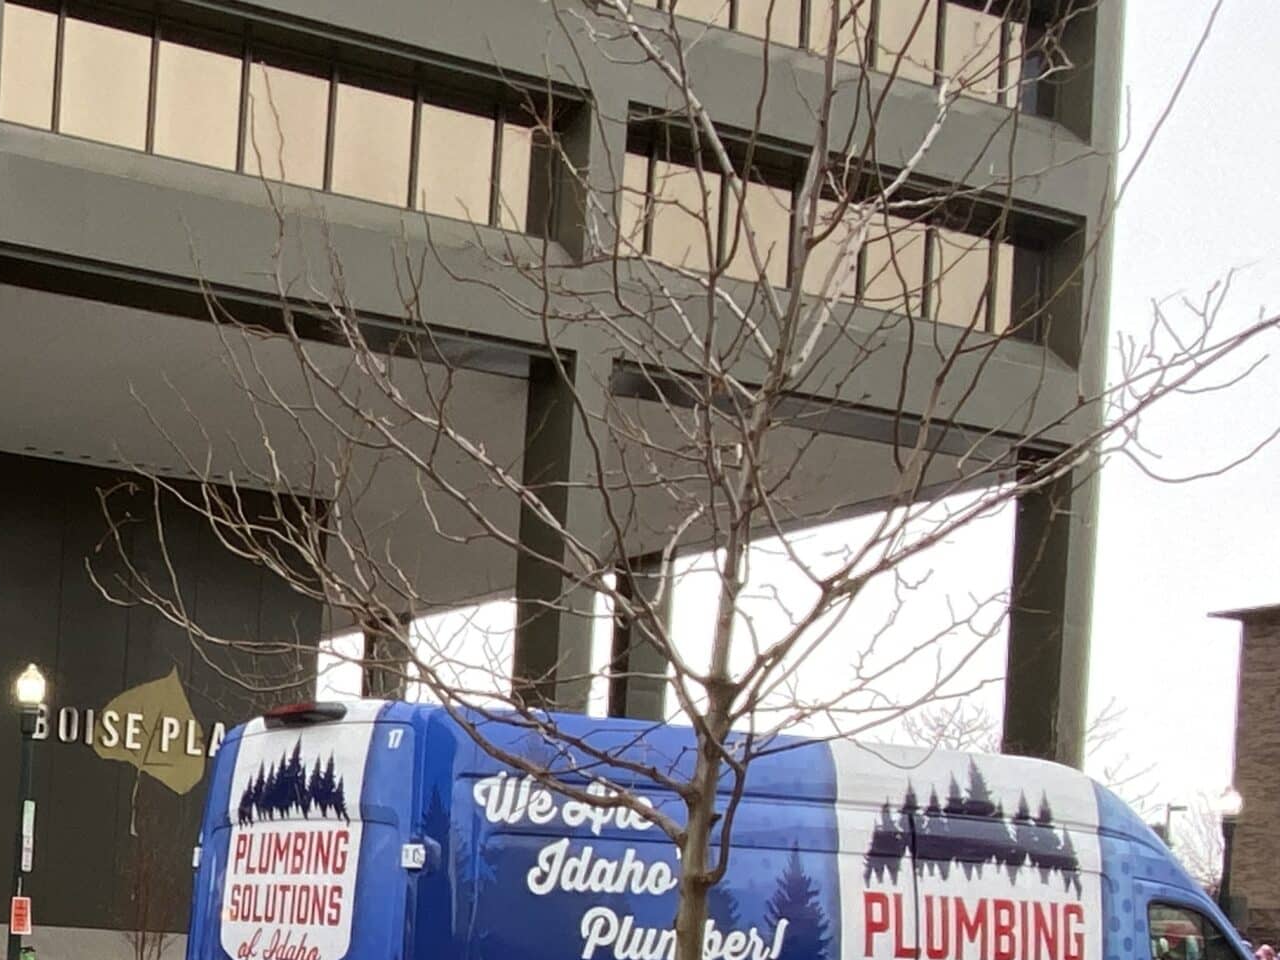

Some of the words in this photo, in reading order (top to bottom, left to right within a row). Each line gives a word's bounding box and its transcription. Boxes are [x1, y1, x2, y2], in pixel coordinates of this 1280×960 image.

[32, 703, 144, 750] BOISE
[388, 728, 404, 749] 17
[473, 770, 557, 824] We
[233, 830, 350, 875] PLUMBING
[229, 884, 343, 926] SOLUTIONS
